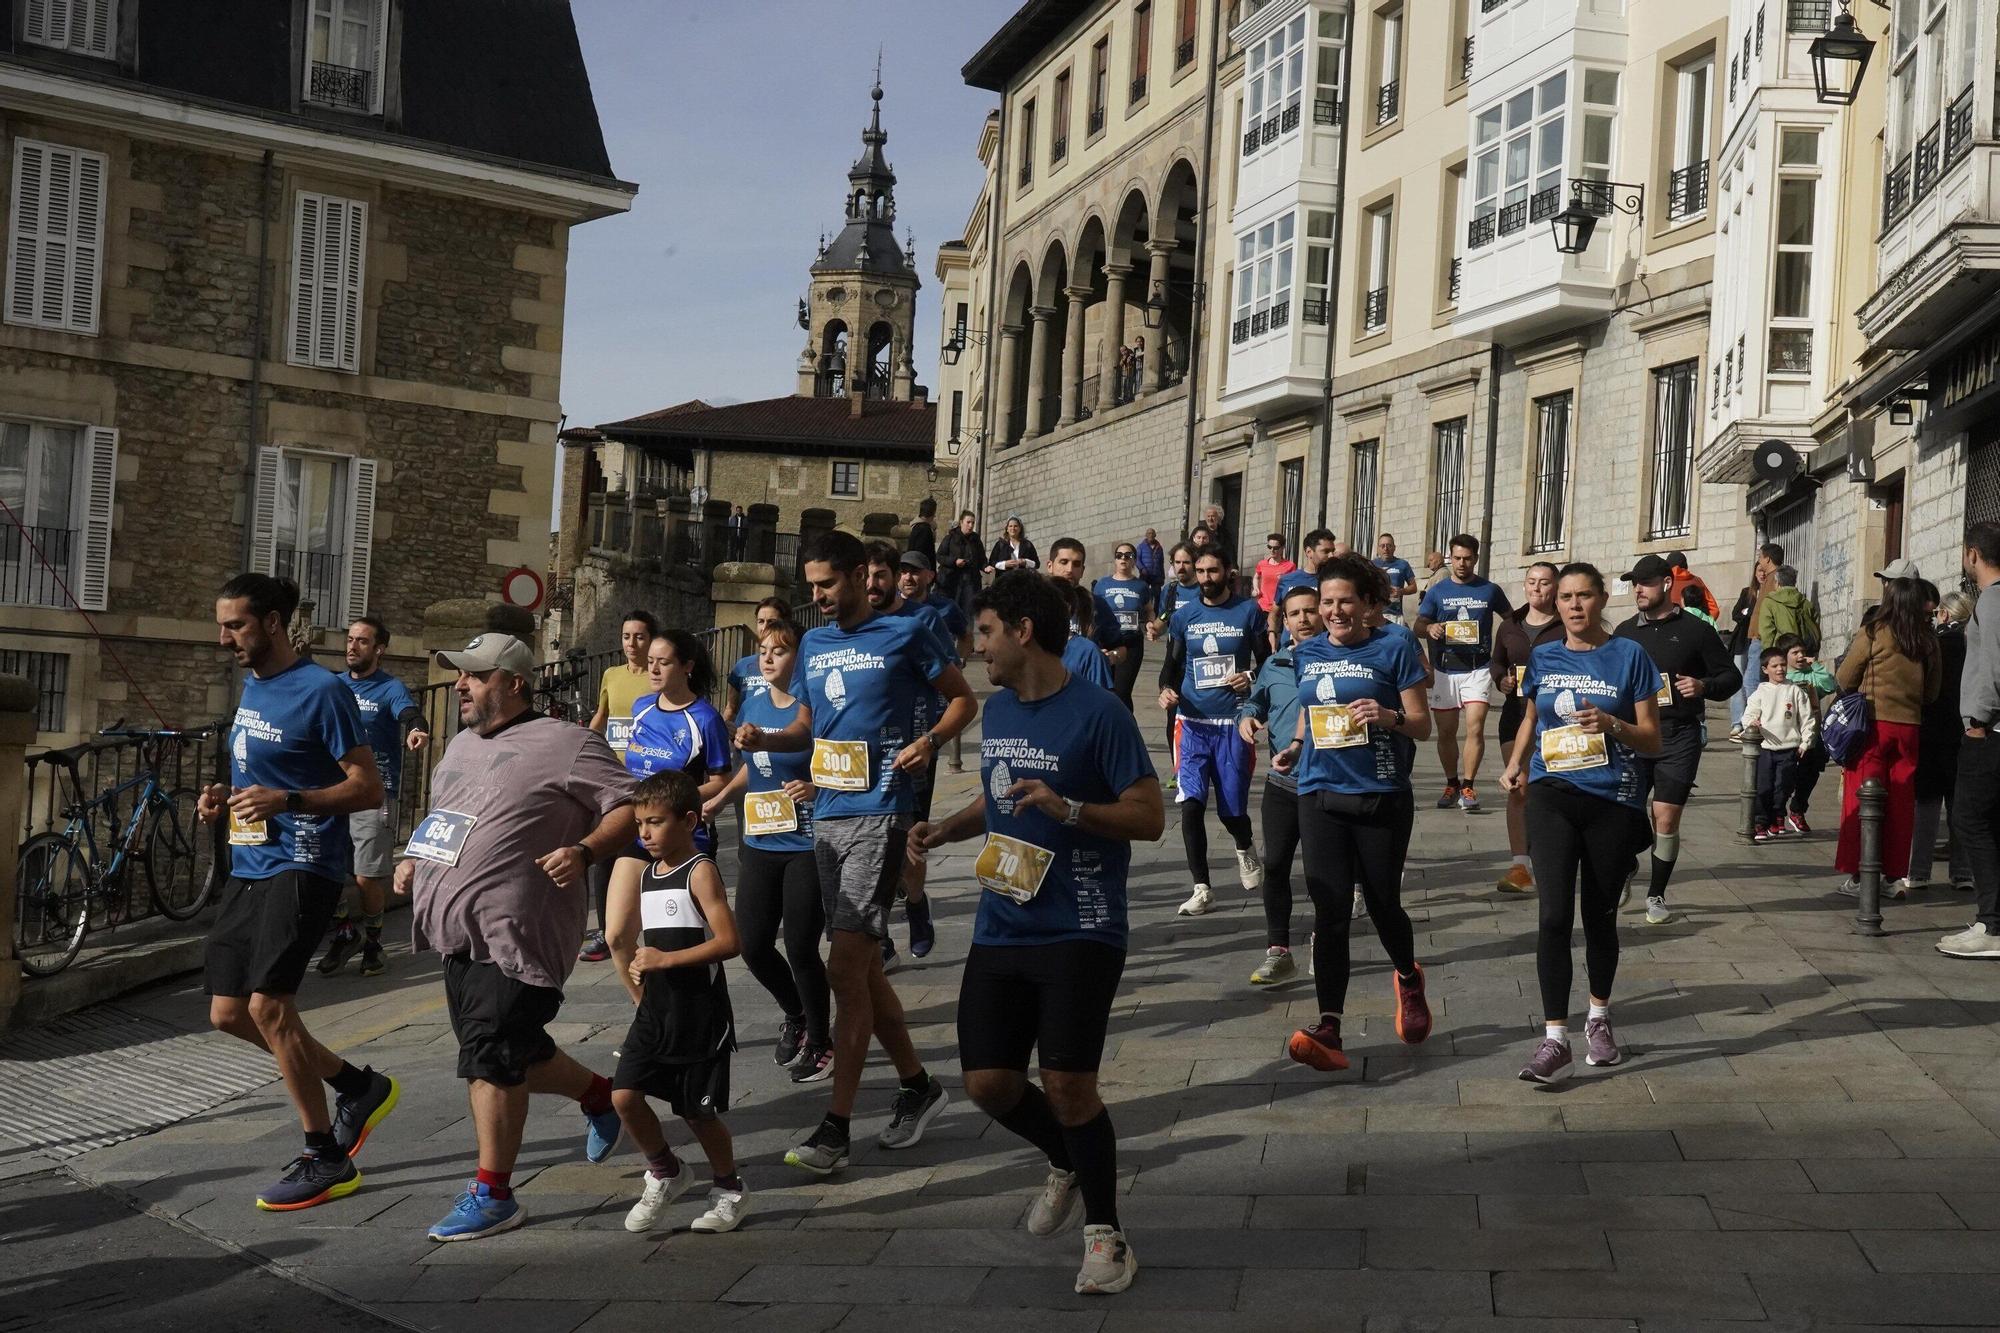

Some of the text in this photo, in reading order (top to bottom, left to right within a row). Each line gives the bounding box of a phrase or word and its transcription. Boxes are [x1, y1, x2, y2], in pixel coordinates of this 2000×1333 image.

[1875, 500, 1881, 508] 2
[1195, 626, 1236, 635] ALMENDRA
[1454, 627, 1470, 636] 235
[815, 648, 856, 663] CONQUISTA
[815, 653, 872, 670] ALMENDRA
[843, 661, 885, 673] KONKISTA
[1202, 663, 1227, 677] 1081
[1308, 664, 1363, 675] ALMENDRA
[1310, 660, 1349, 669] CONQUISTA
[1334, 671, 1374, 680] KONKISTA
[1546, 680, 1607, 689] ALMENDRA
[1575, 688, 1617, 699] KONKISTA
[1326, 715, 1350, 731] 491
[985, 738, 1028, 748] CONQUISTA
[1557, 735, 1588, 754] 459
[983, 746, 1059, 762] ALMENDRA REN
[823, 752, 851, 772] 300
[1010, 758, 1059, 772] KONKISTA
[755, 801, 782, 819] 692
[425, 820, 456, 843] 854
[995, 851, 1019, 876] 70
